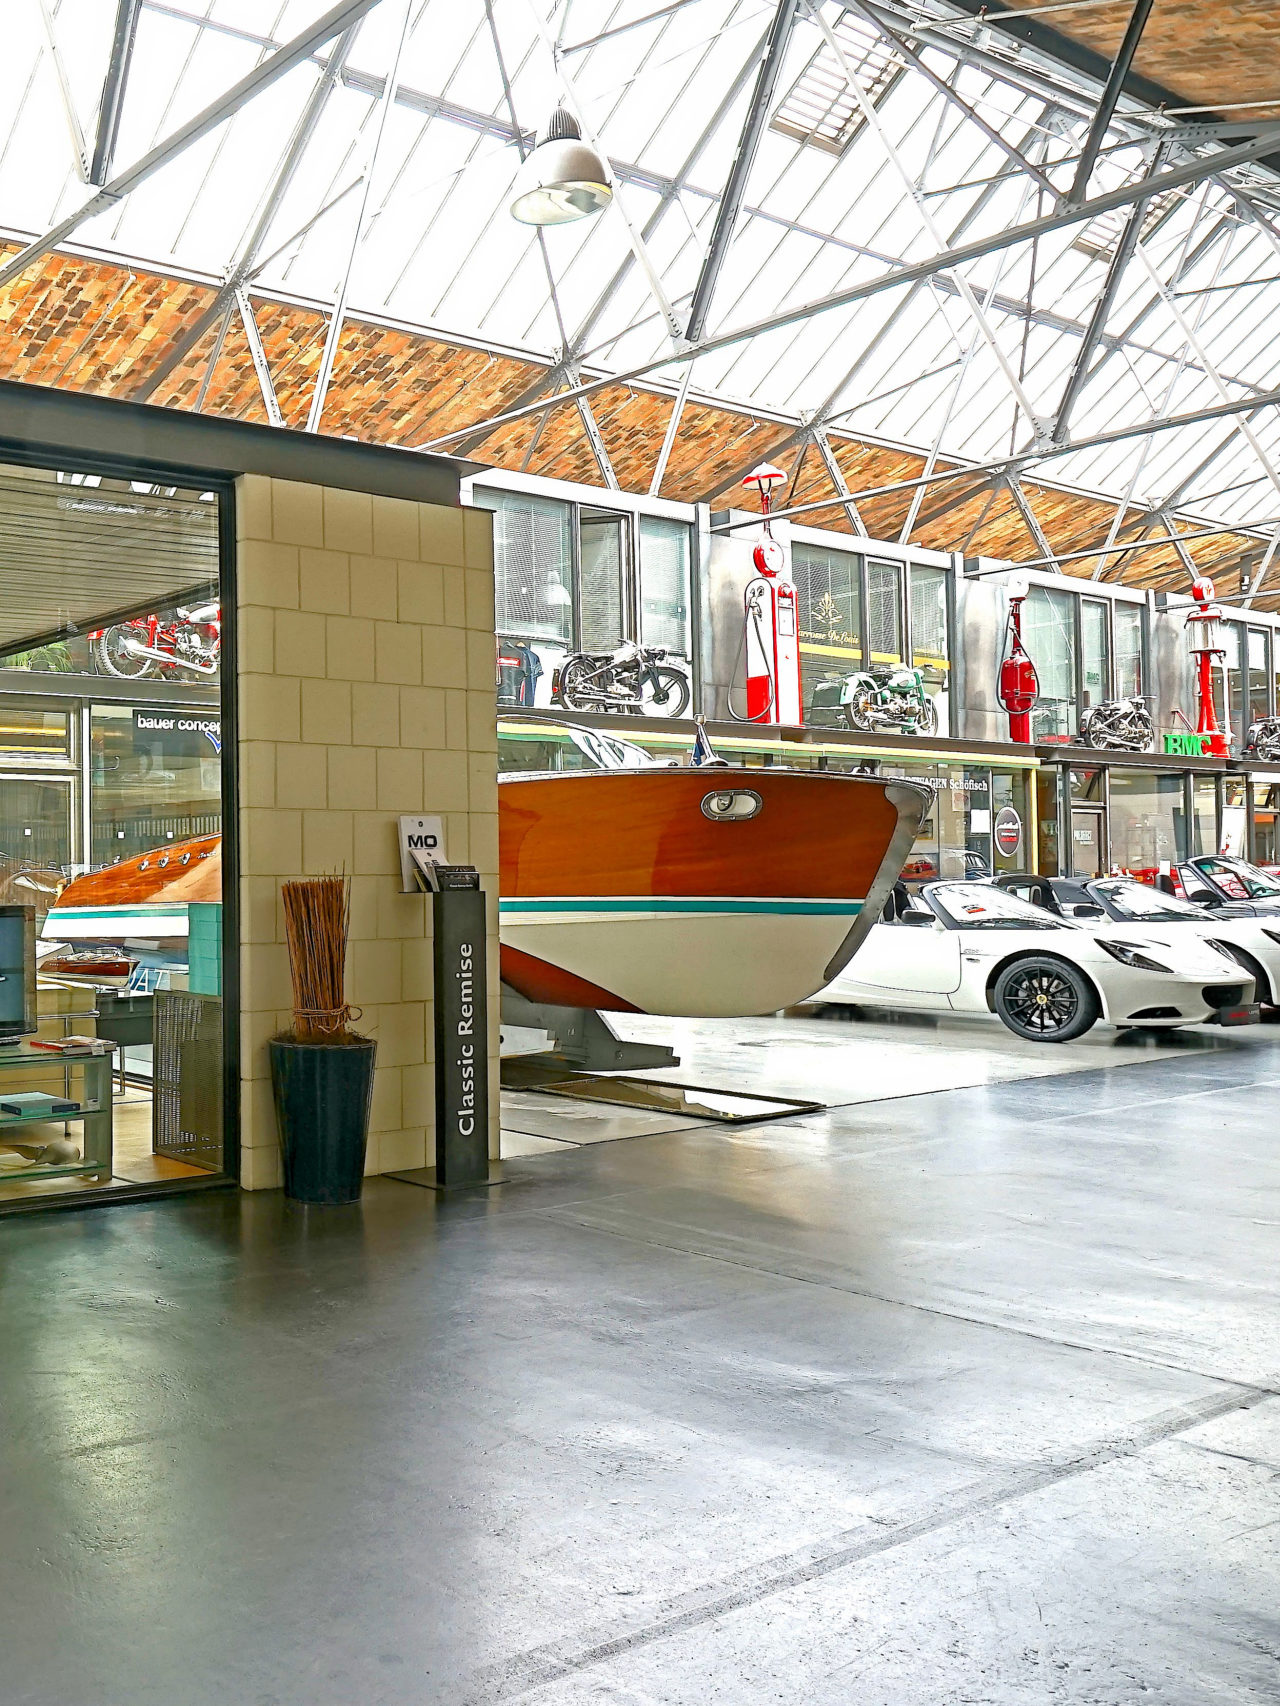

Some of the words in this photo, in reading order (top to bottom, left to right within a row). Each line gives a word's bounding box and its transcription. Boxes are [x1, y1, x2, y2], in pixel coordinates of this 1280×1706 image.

[137, 713, 175, 730] bauer
[1163, 734, 1212, 757] BMC
[949, 778, 988, 792] Schöfisch
[456, 943, 474, 1036] Remise
[457, 1044, 475, 1136] Classic
